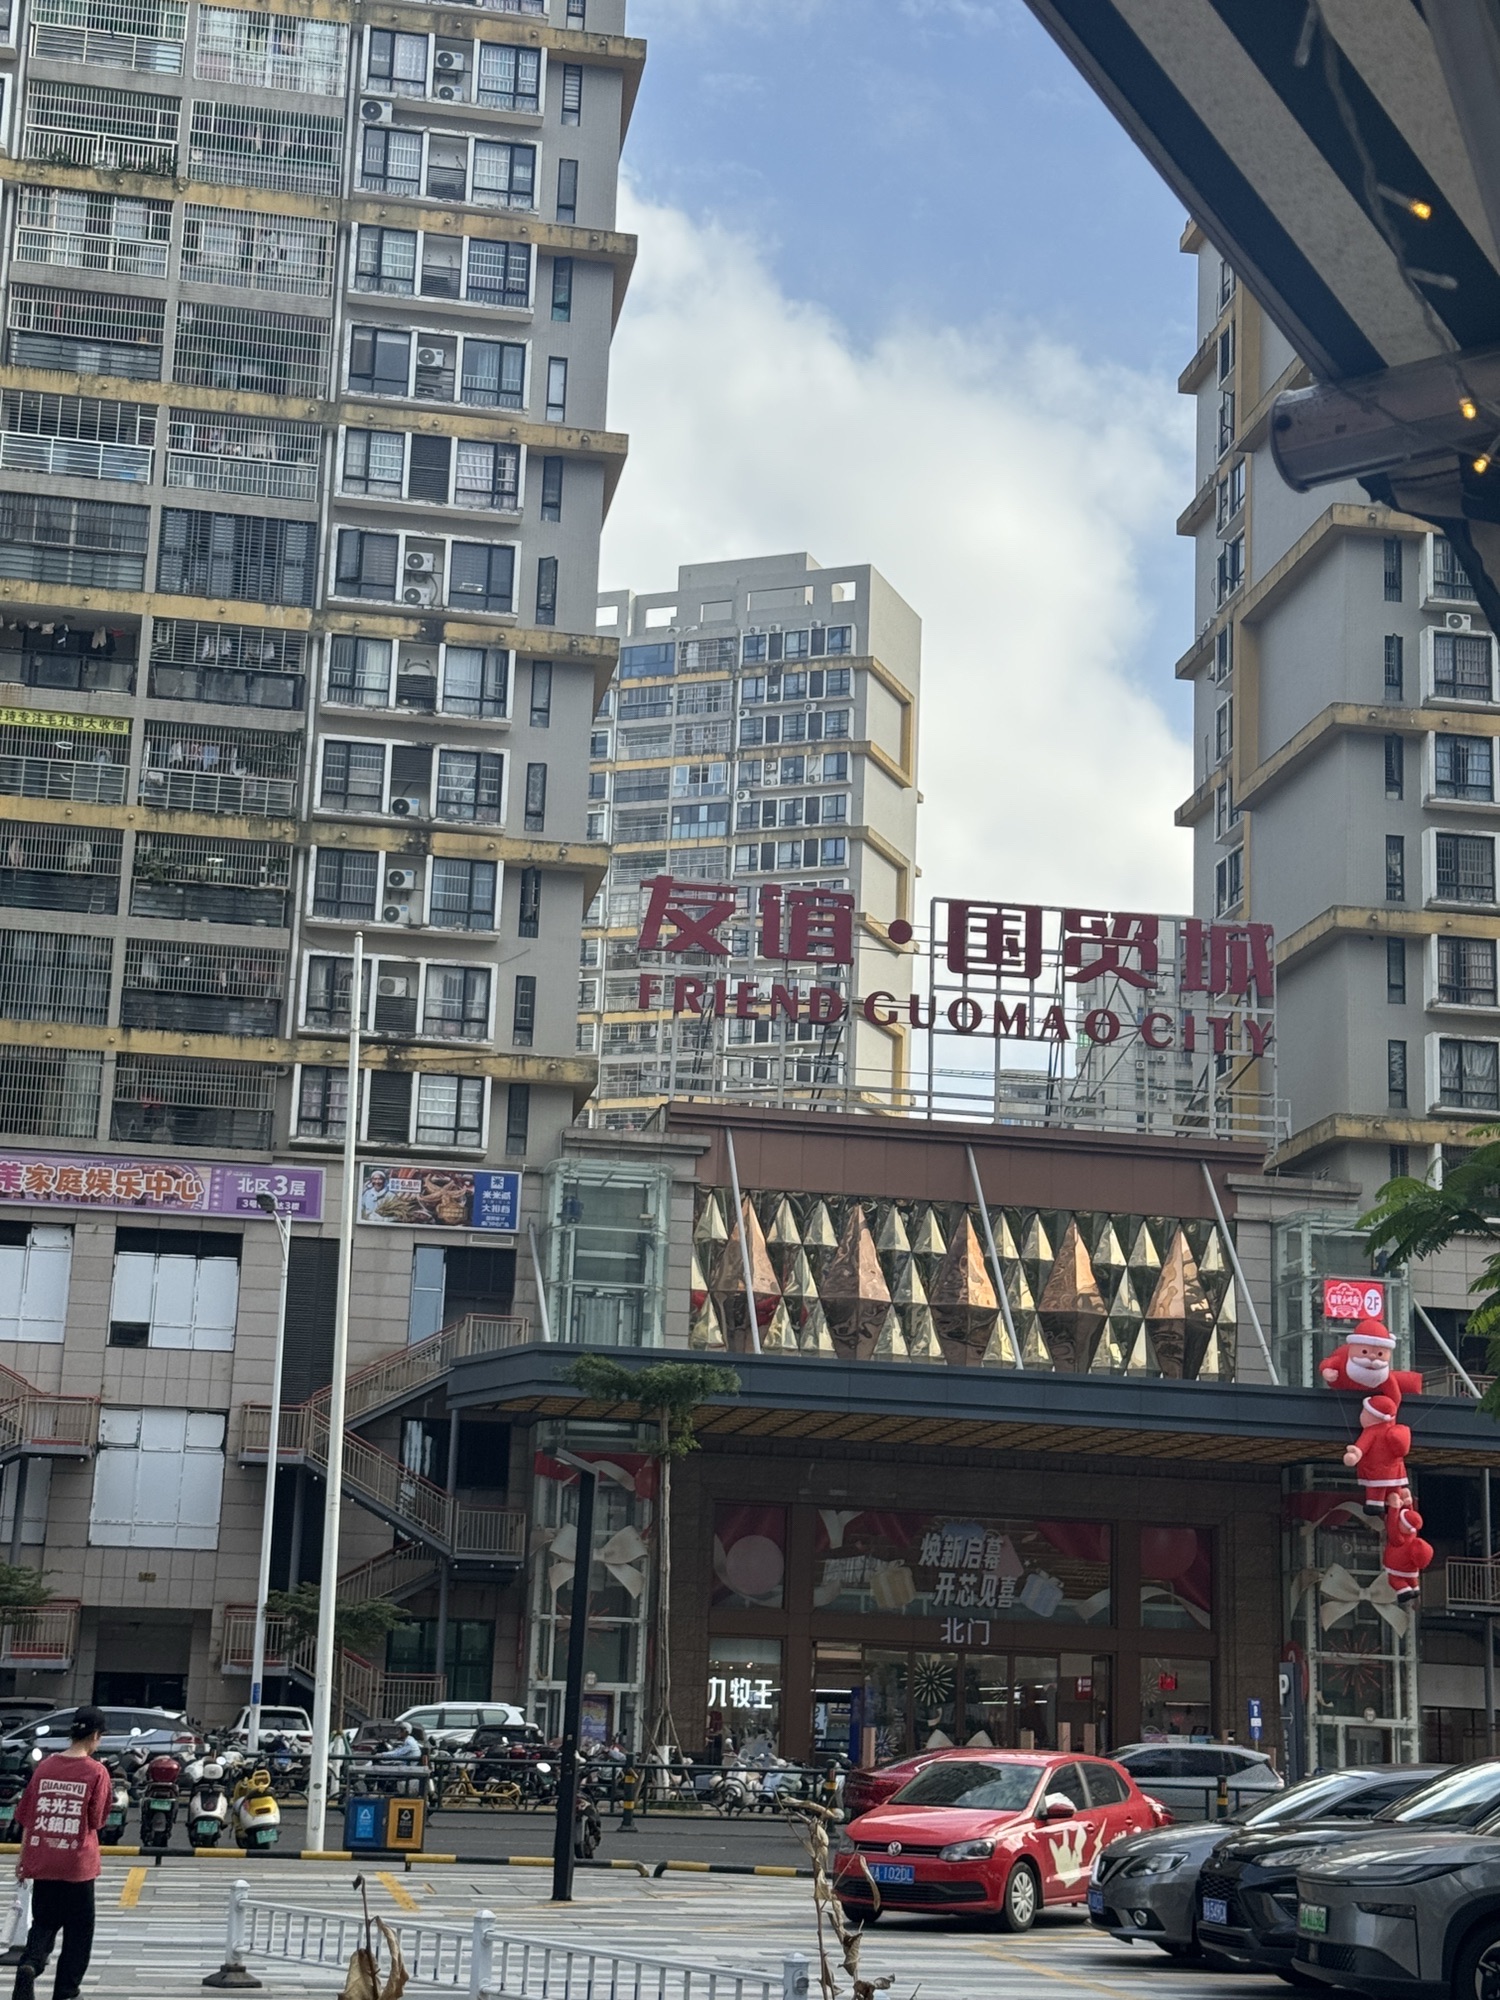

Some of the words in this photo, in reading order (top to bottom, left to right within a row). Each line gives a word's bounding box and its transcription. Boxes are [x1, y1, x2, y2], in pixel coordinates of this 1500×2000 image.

[638, 973, 843, 1025] FRIEND
[864, 990, 1121, 1044] GUOMAO
[1141, 1012, 1273, 1058] CITY
[237, 1174, 307, 1197] 北区3层
[1367, 1297, 1379, 1310] 2F
[918, 1532, 1004, 1570] 焕新启幕
[932, 1571, 1018, 1609] 开芯见喜
[940, 1617, 990, 1646] 北门
[707, 1676, 774, 1710] 九牧王
[1278, 1673, 1291, 1706] P
[41, 1781, 85, 1795] GUANGYU
[37, 1797, 83, 1815] 朱光玉
